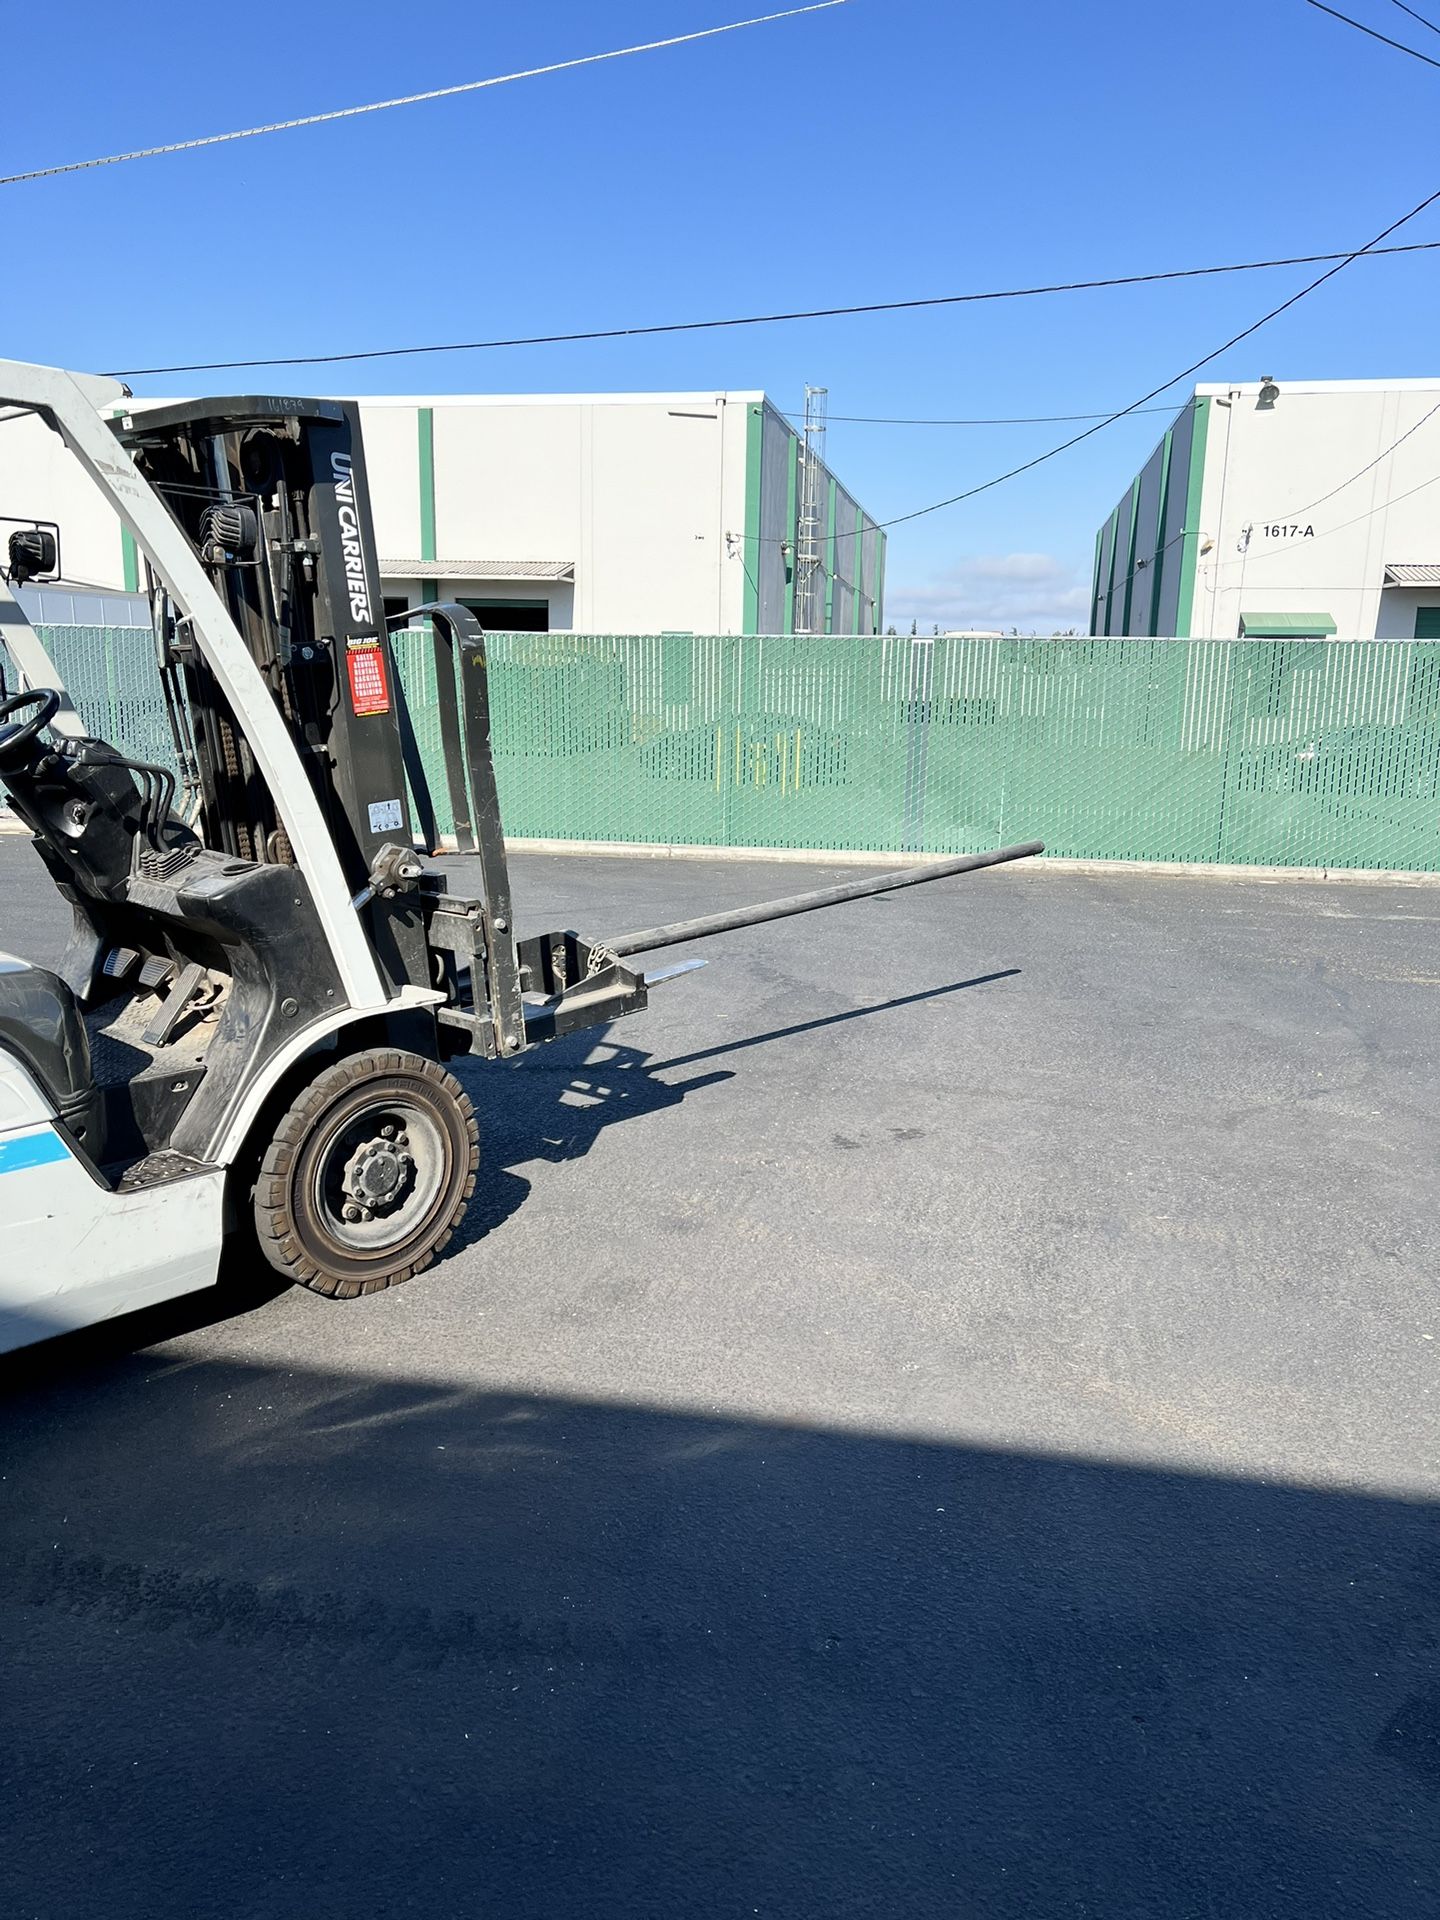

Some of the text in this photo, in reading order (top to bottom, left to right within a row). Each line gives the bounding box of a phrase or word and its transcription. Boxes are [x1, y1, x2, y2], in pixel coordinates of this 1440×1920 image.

[1263, 525, 1315, 537] 1617-A
[330, 451, 371, 624] UNICARRIERS
[347, 636, 379, 646] BIG JOE
[356, 653, 374, 662] SALES
[353, 660, 378, 669] SERVICE
[354, 667, 379, 676] RENTALS
[354, 674, 381, 683] RACKING
[354, 680, 382, 690] SHELVING
[355, 687, 383, 697] TRAINING
